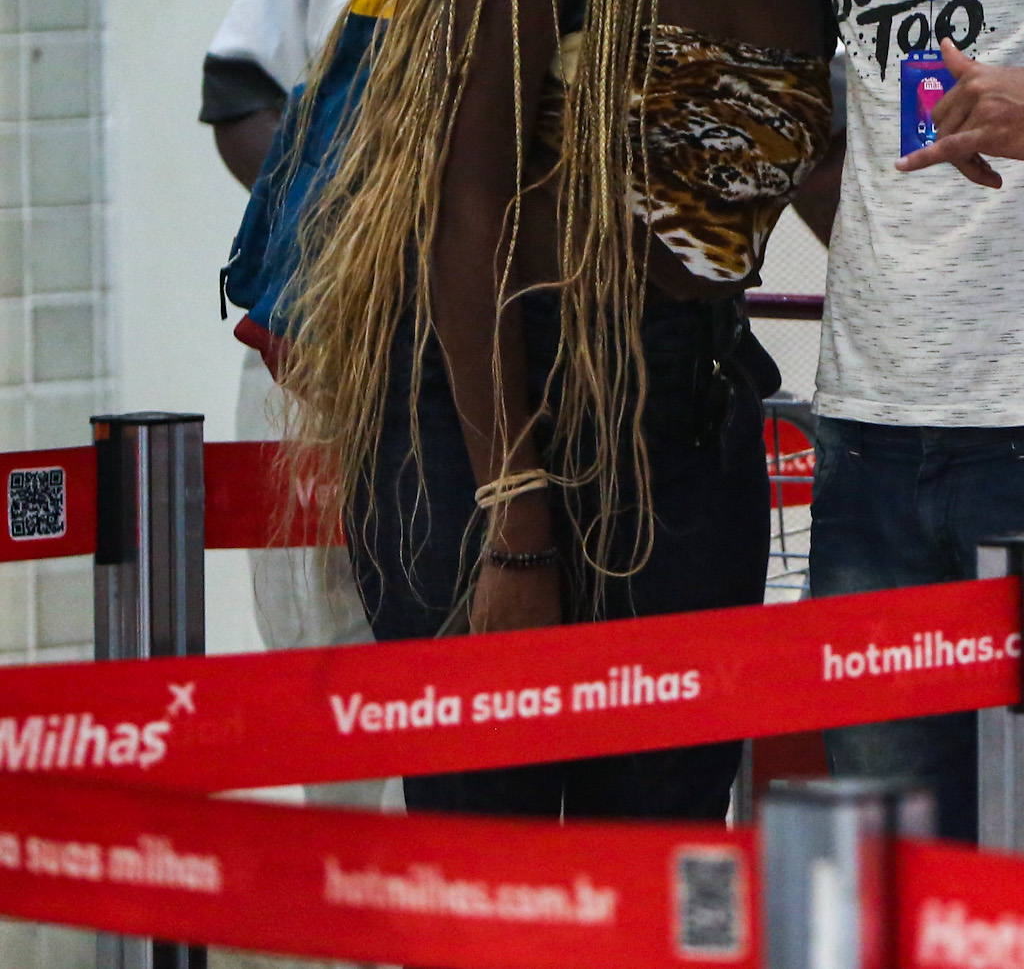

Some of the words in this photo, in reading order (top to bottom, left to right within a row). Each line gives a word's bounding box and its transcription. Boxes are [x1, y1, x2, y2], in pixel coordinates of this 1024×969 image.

[330, 685, 462, 734] Venda
[472, 685, 563, 723] suas
[571, 664, 701, 712] milhas
